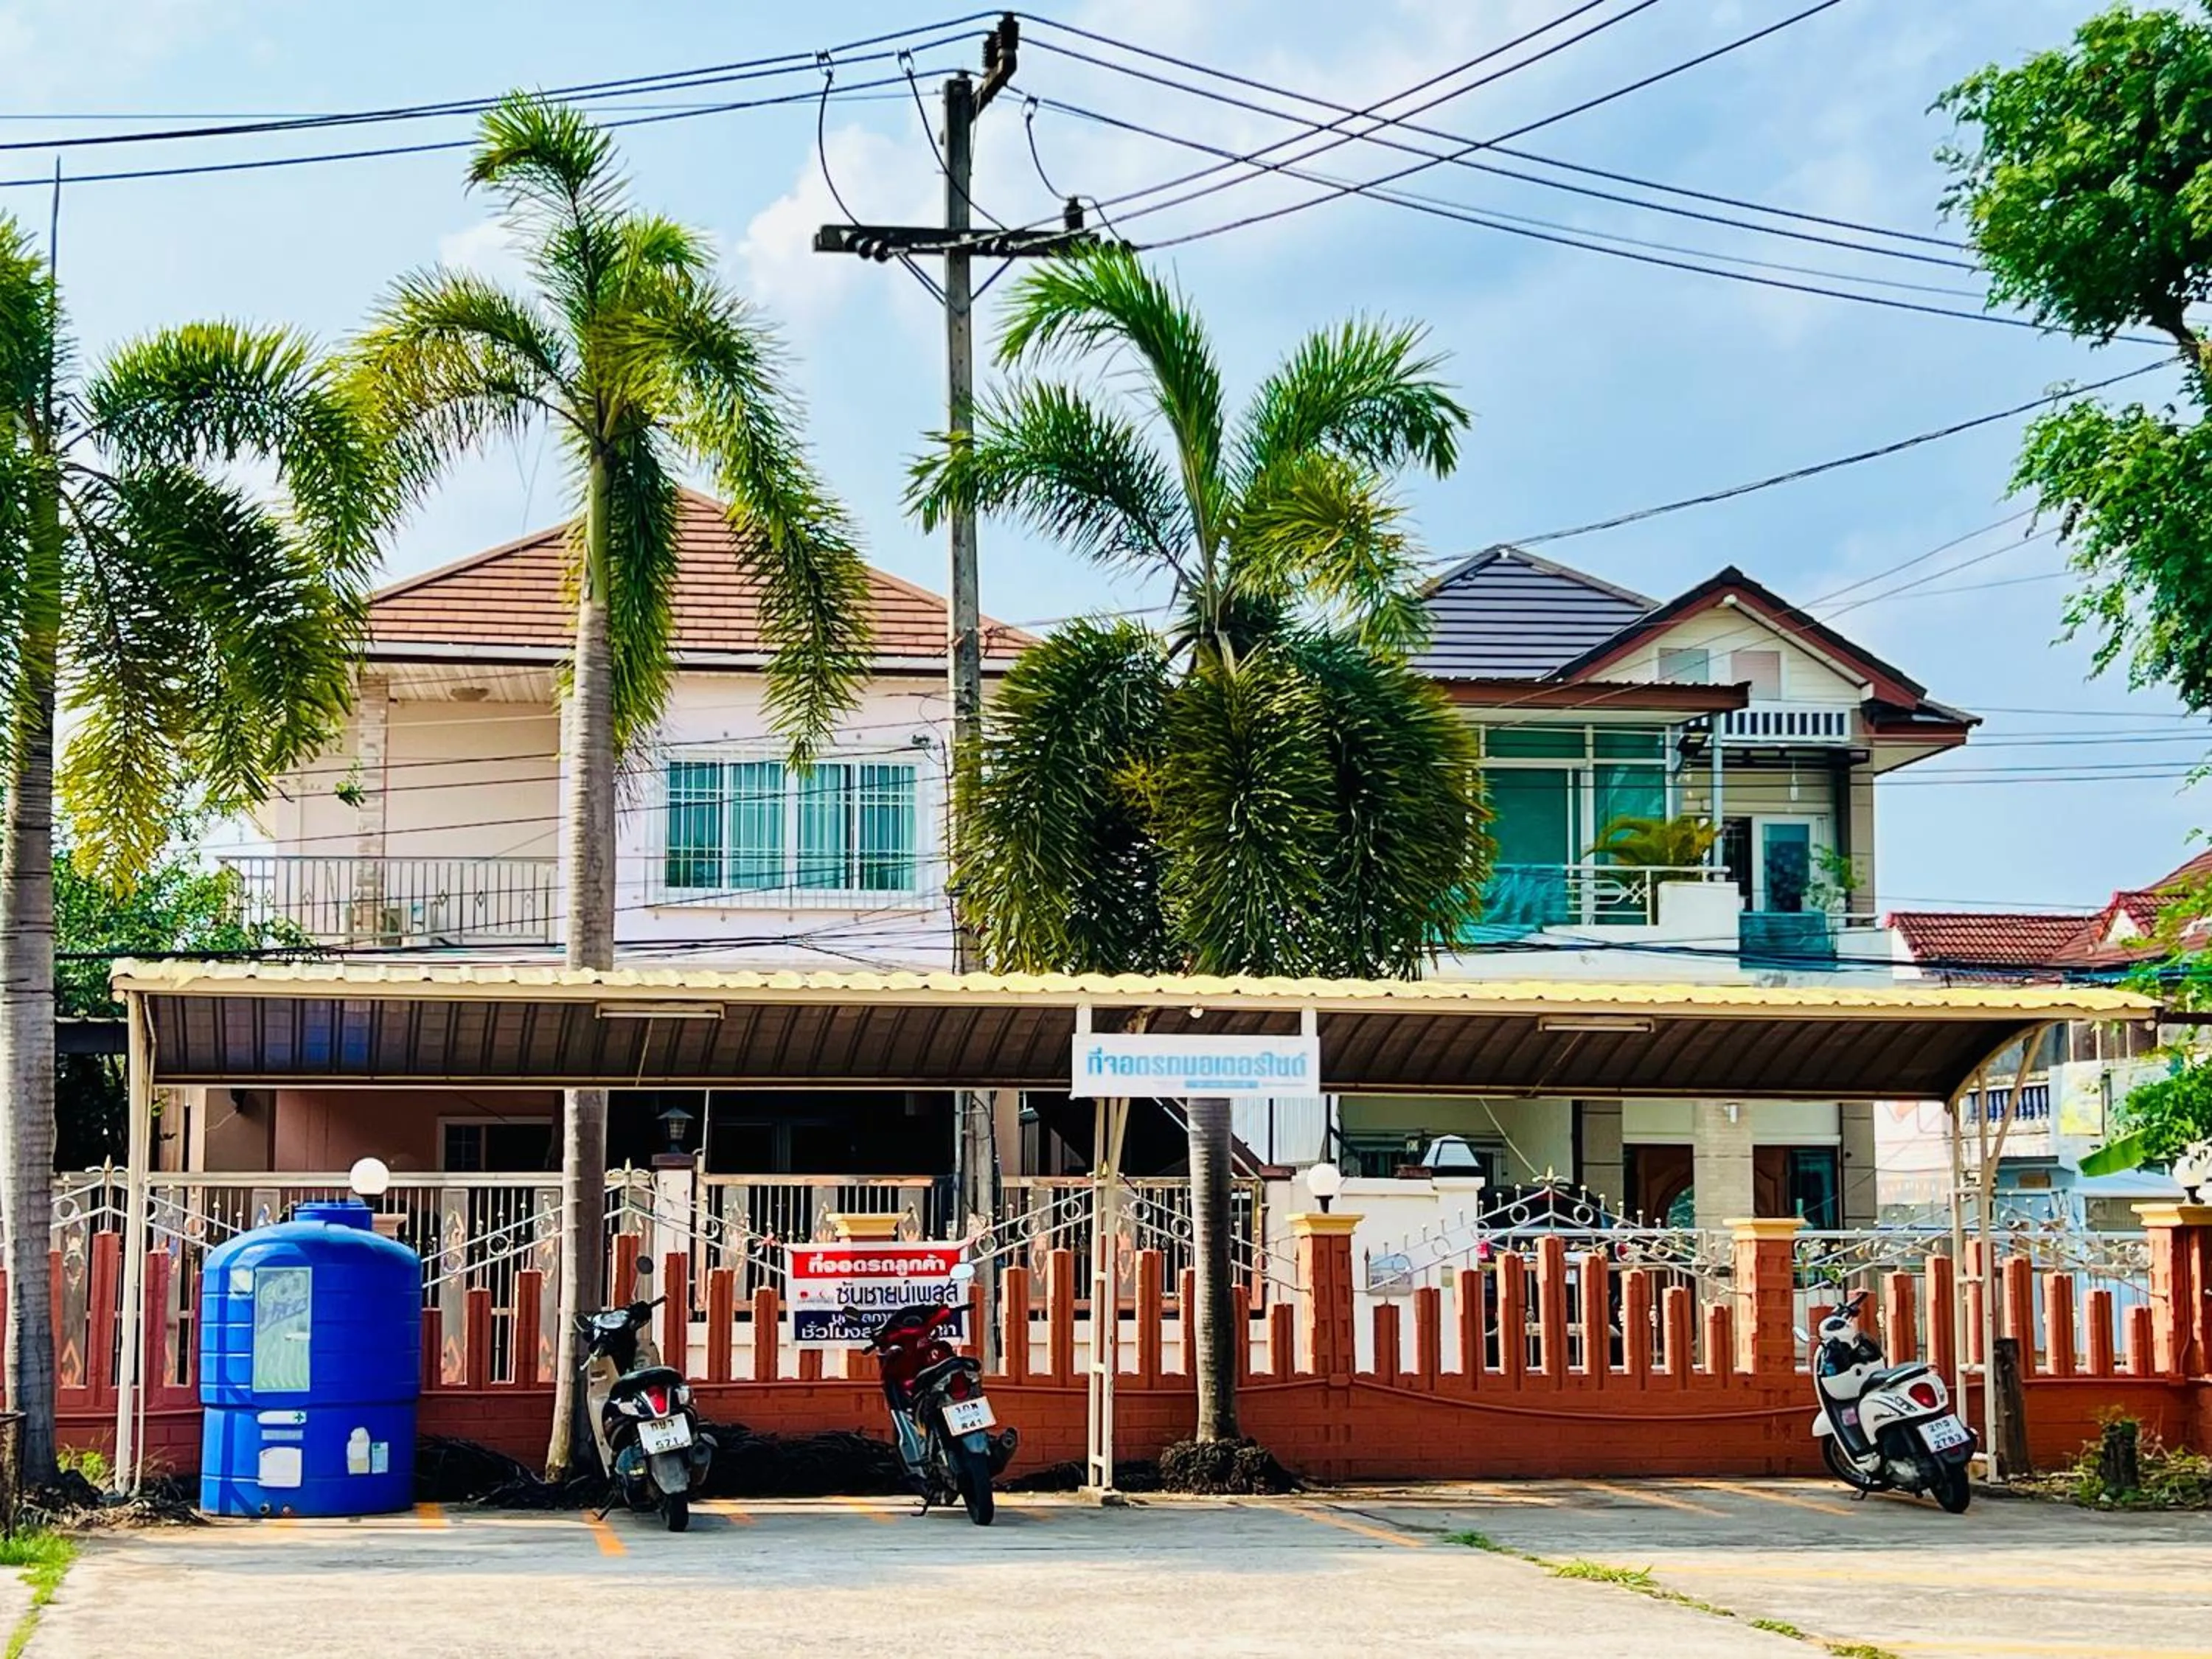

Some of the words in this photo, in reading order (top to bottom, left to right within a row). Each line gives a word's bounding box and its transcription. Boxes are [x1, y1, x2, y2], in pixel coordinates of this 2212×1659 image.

[808, 1252, 946, 1276] ที่จอดรถลูกค้า
